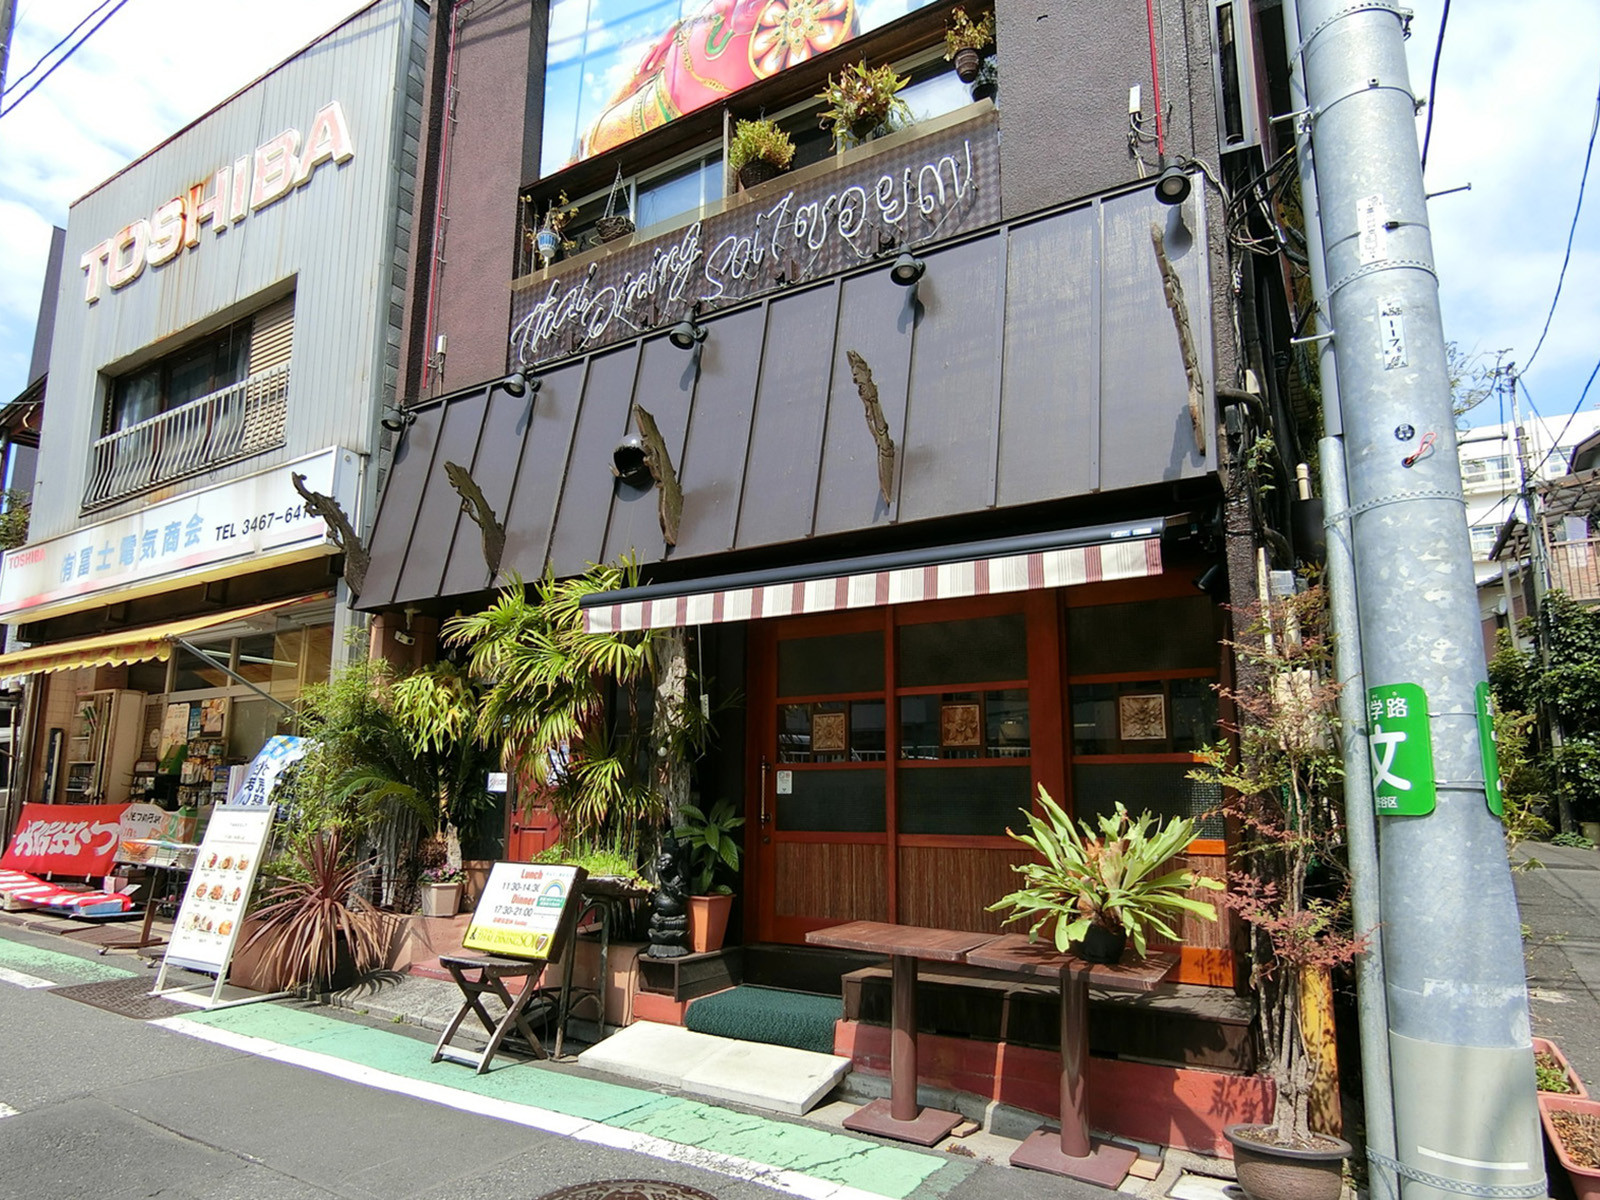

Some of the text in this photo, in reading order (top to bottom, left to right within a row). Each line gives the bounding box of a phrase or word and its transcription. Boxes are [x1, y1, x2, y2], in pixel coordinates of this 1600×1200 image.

[80, 100, 355, 304] TOSHIBA
[582, 221, 703, 340] Dining
[215, 523, 236, 541] TEL
[8, 548, 46, 570] TOSHIBA
[1376, 796, 1399, 809] 谷区
[521, 868, 543, 880] Lunch
[511, 894, 536, 905] Dinner
